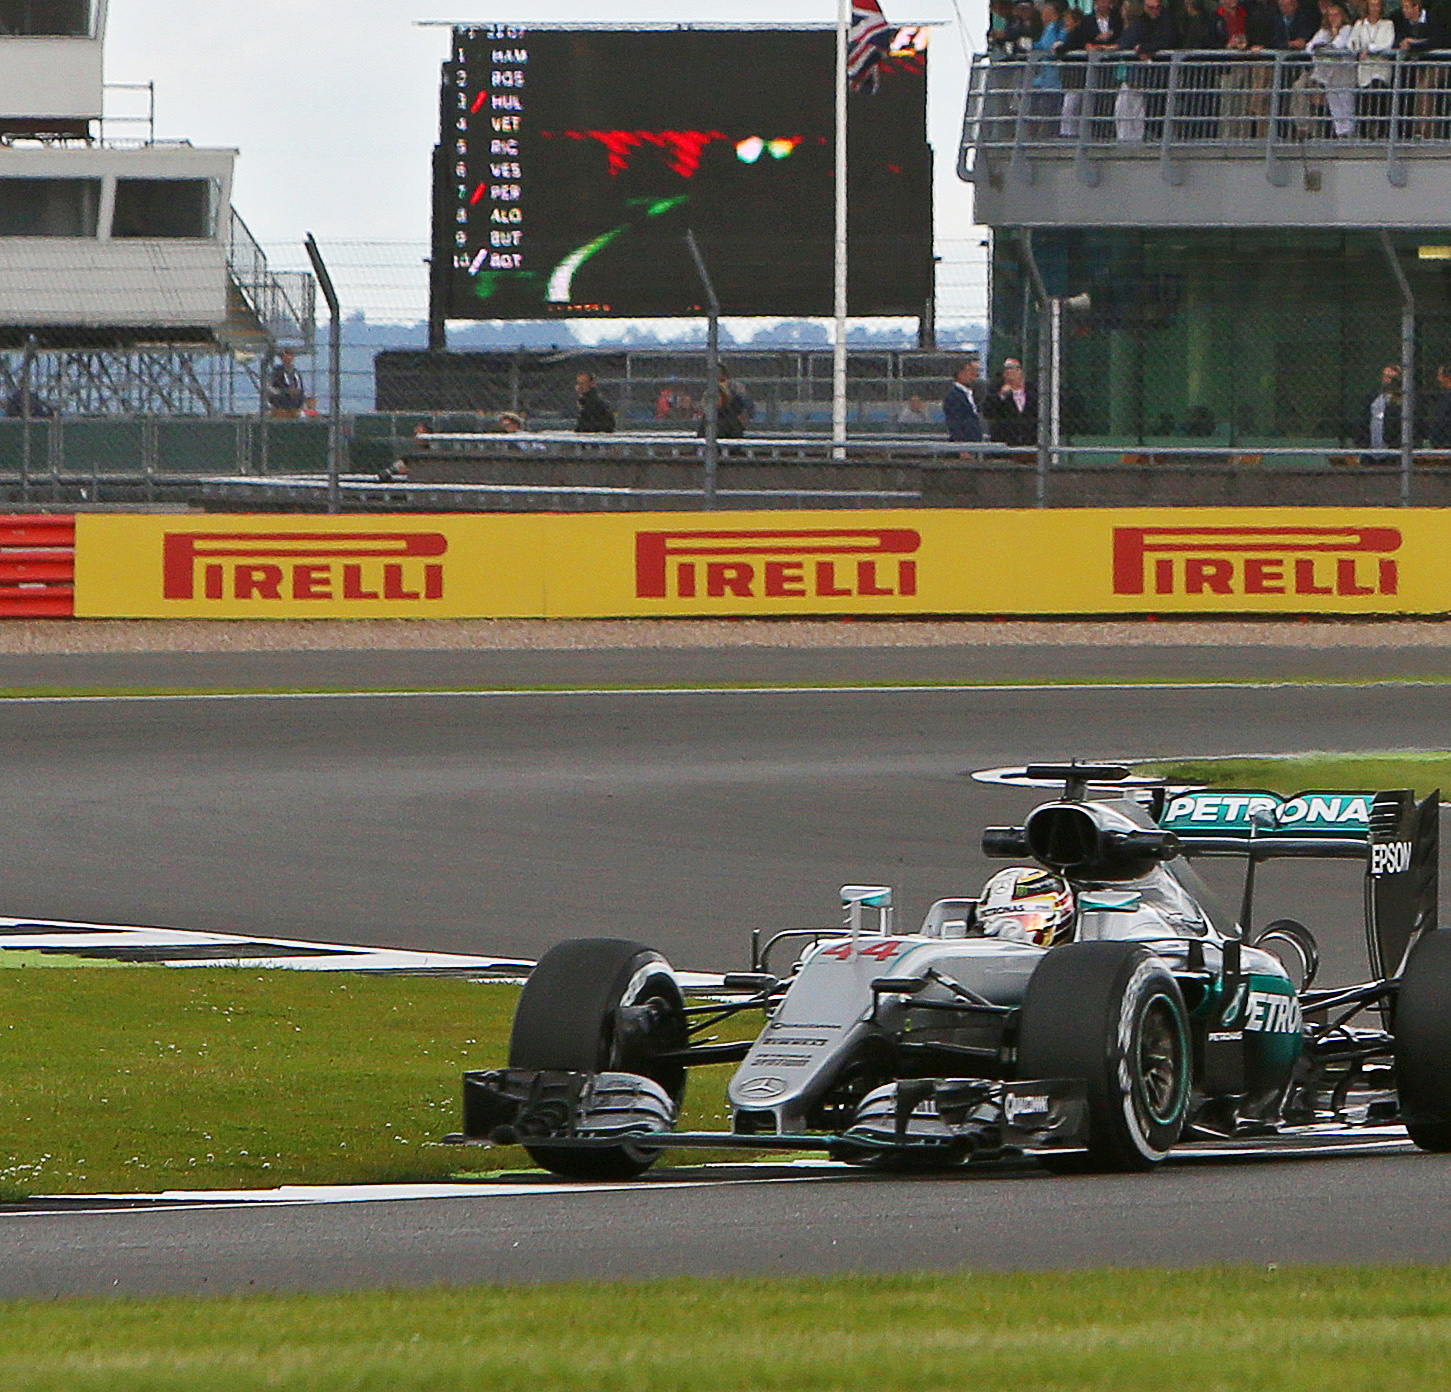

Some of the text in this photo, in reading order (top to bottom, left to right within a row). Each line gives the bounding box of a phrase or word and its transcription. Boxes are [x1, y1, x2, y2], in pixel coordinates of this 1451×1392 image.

[491, 94, 524, 111] HUL
[491, 116, 522, 133] VET
[163, 532, 448, 600] PIRELLI
[635, 528, 921, 598] PIRELLI
[1113, 526, 1402, 596] PIRELLI
[1371, 841, 1413, 875] EPSON
[821, 940, 901, 962] 44
